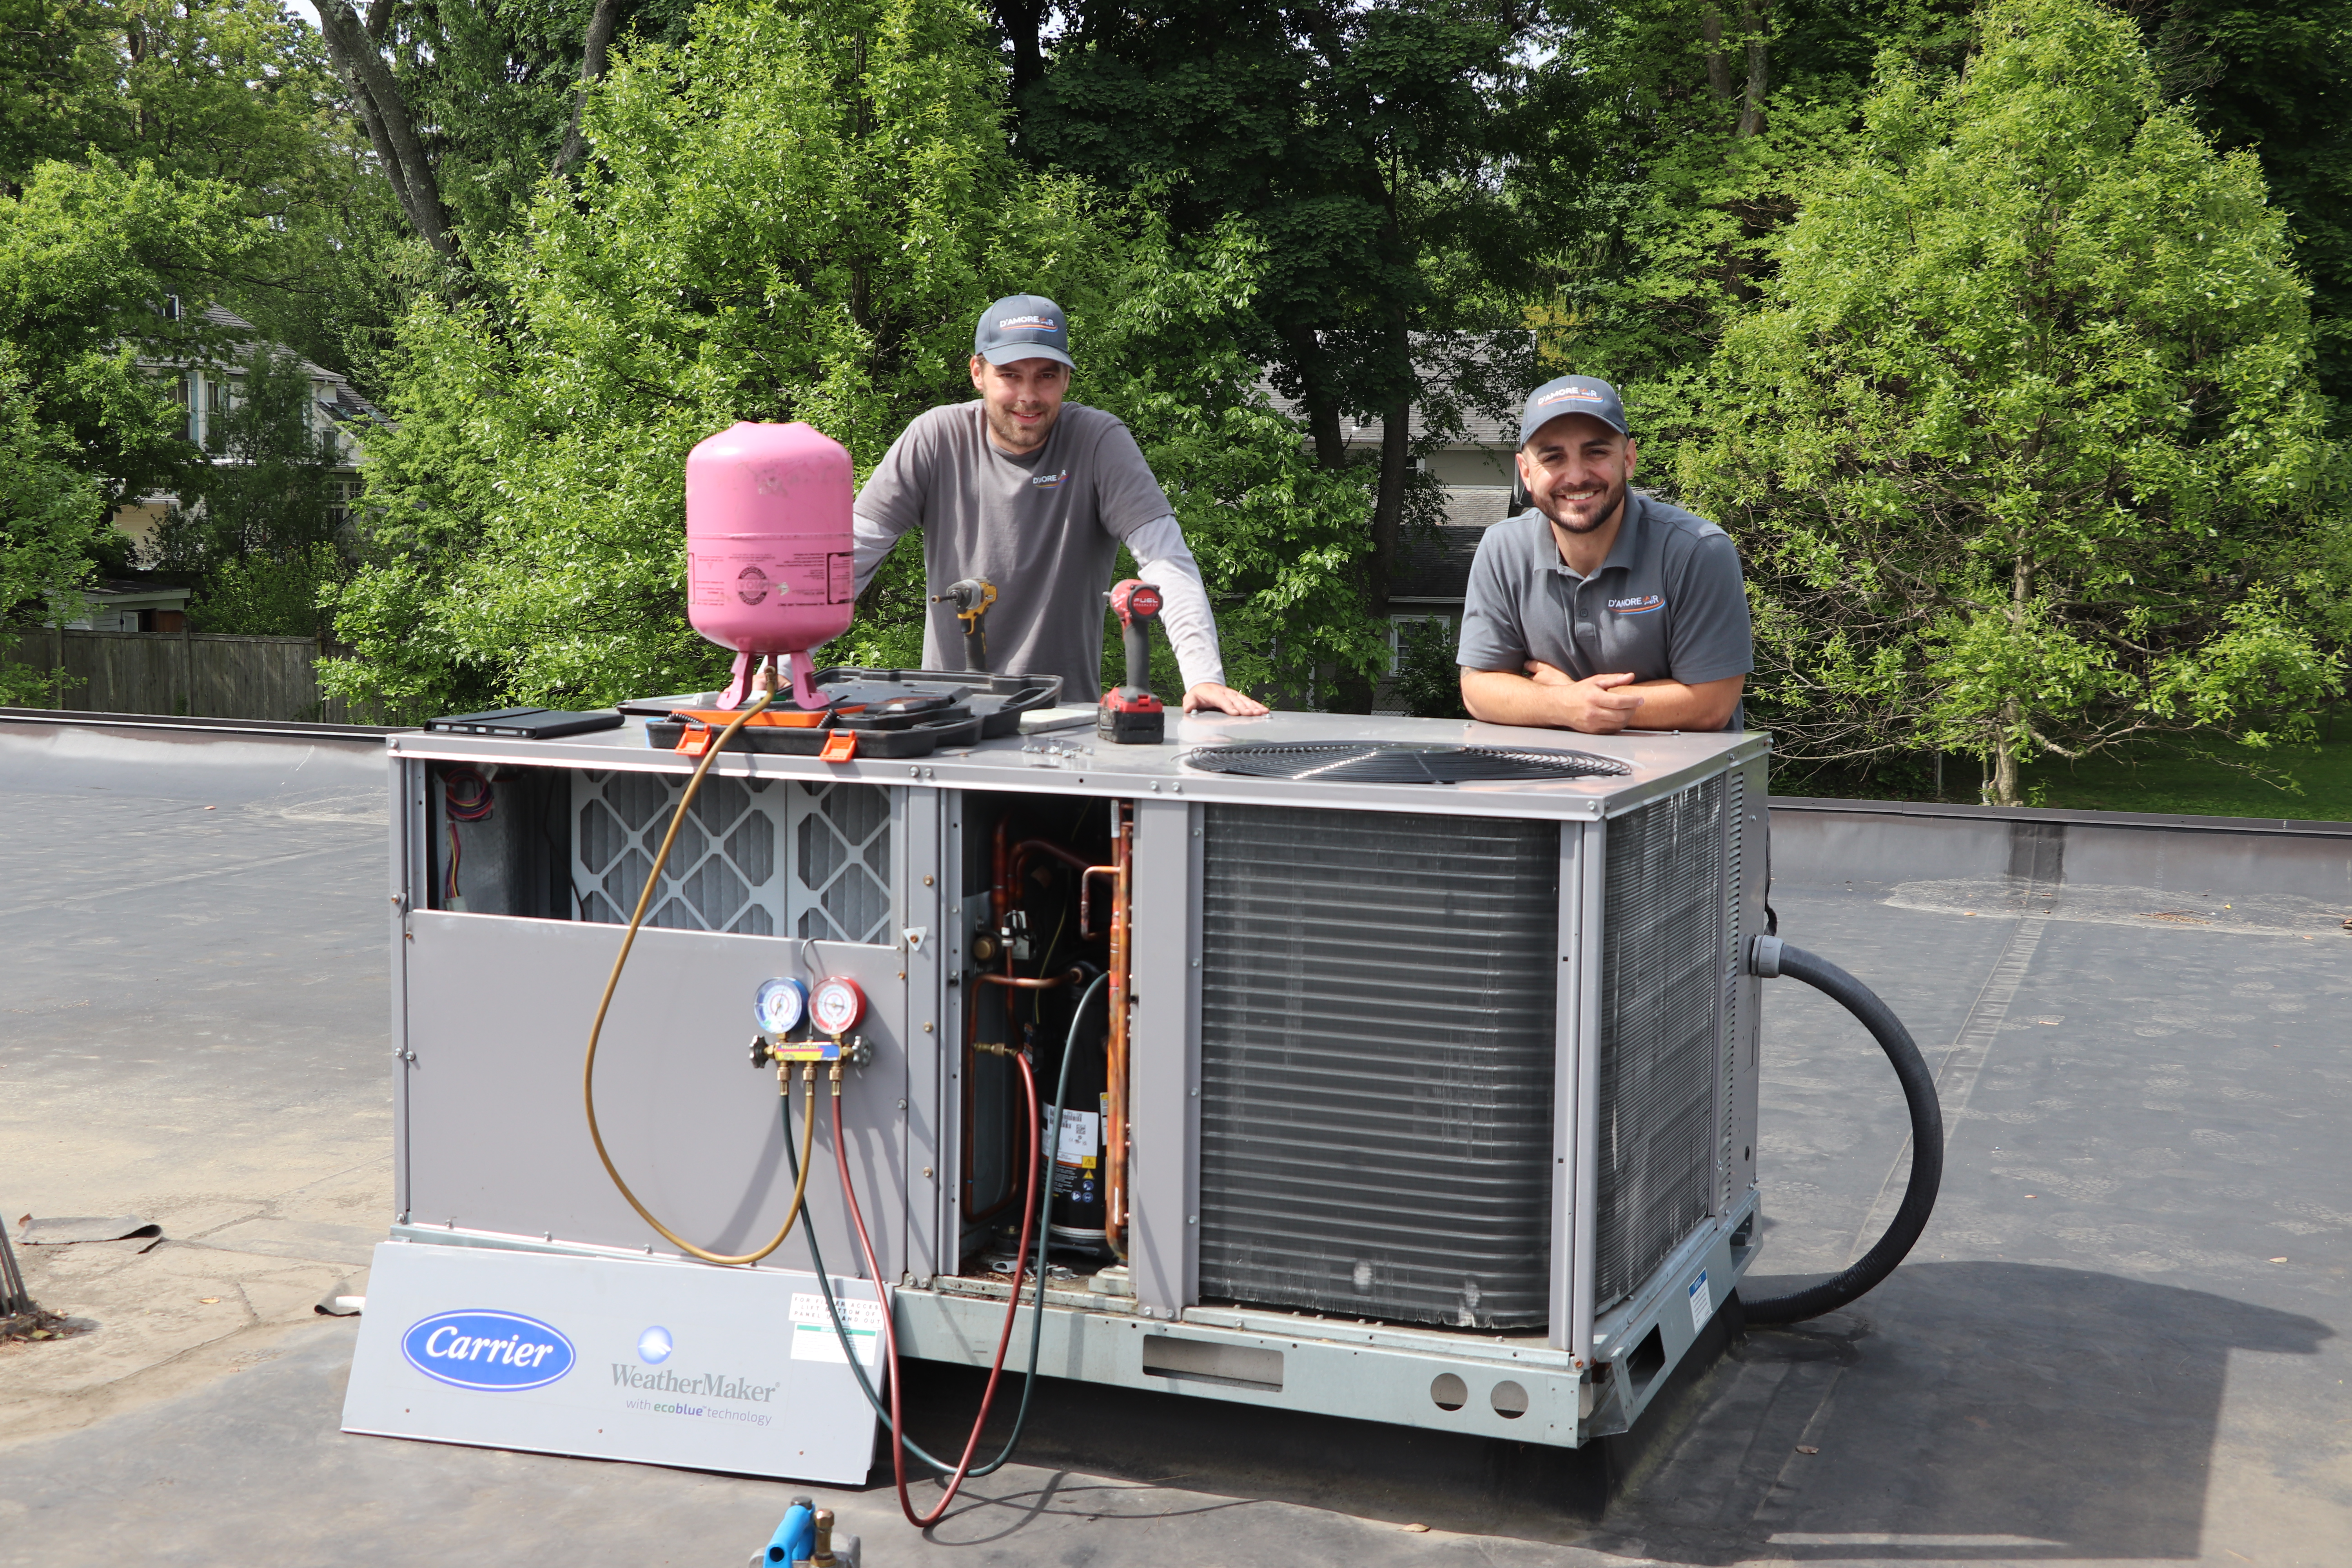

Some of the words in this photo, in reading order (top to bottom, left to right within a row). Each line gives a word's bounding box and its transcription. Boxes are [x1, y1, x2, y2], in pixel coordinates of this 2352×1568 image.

[1000, 316, 1039, 328] D'AMORE
[1538, 387, 1579, 405] D'AMORE
[825, 1307, 860, 1316] BTTOM
[426, 1325, 554, 1367] Carrier
[611, 1363, 777, 1403] WeatherMaker
[626, 1399, 651, 1410] with
[707, 1406, 772, 1426] technology
